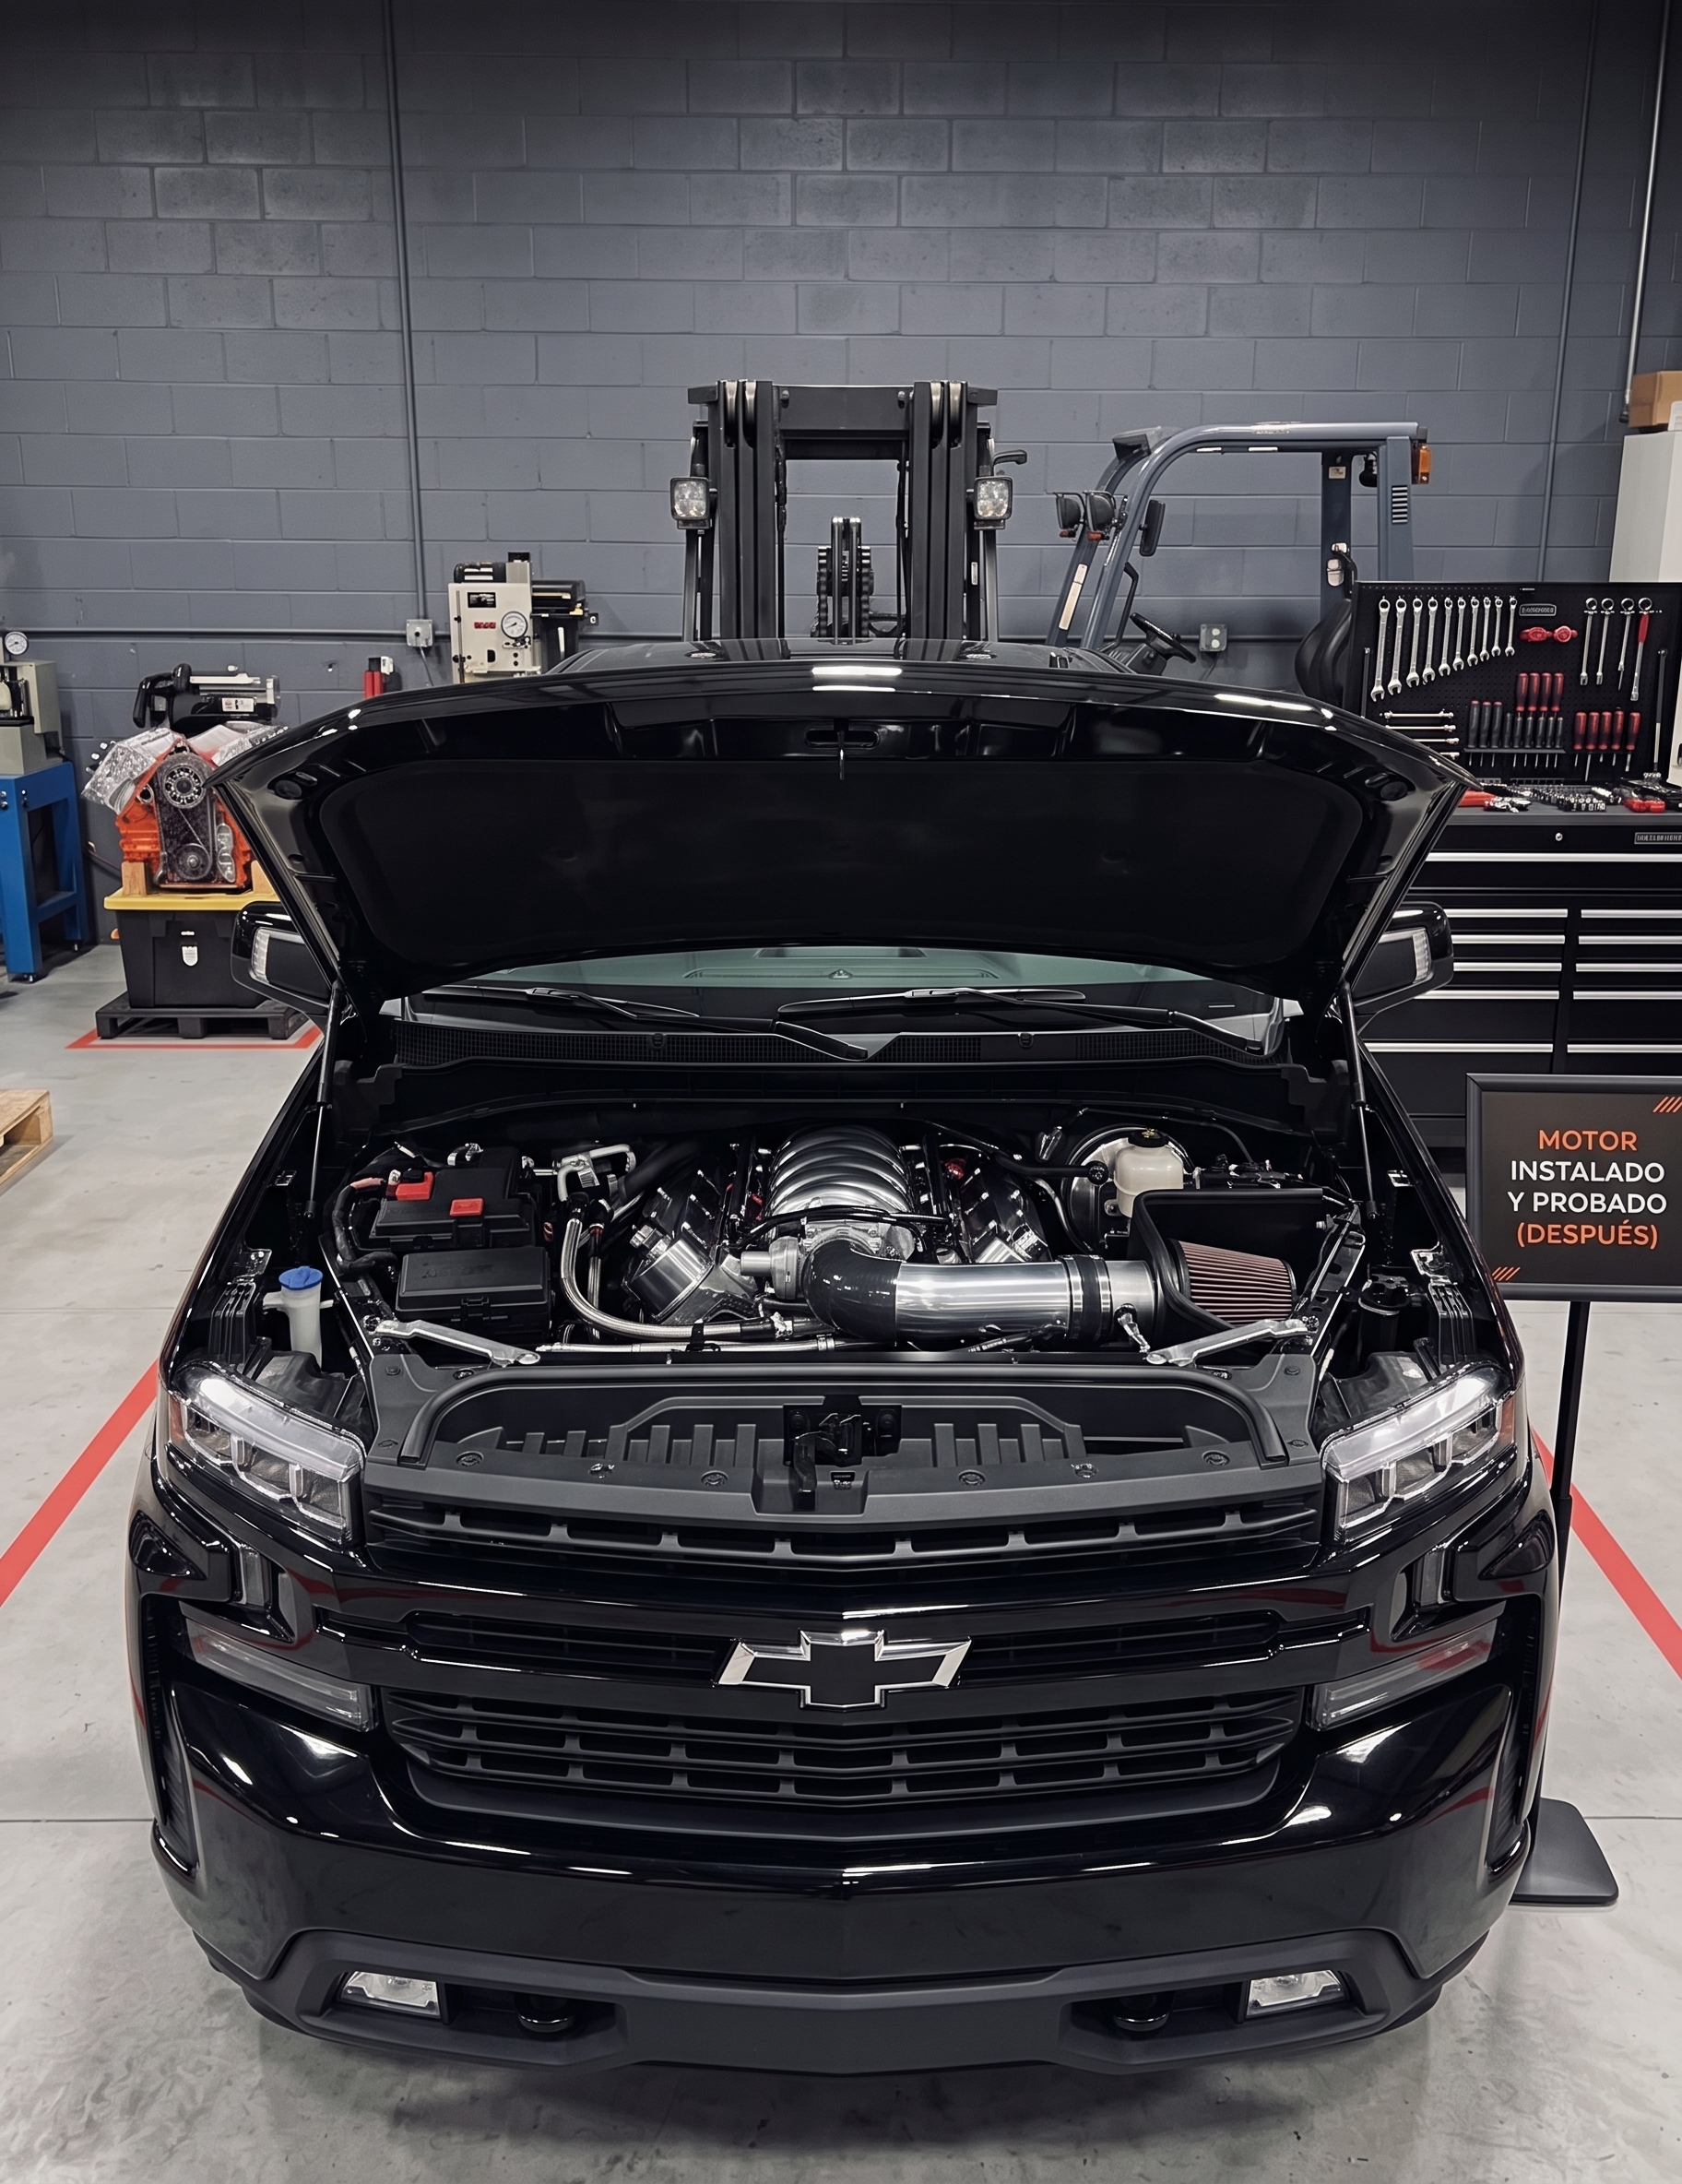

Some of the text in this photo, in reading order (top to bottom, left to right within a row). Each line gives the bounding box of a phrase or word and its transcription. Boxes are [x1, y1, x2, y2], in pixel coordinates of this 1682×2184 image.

[1539, 1130, 1638, 1151] MOTOR
[1510, 1160, 1665, 1183] INSTALADO
[1507, 1192, 1667, 1215] Y PROBADO
[1517, 1219, 1658, 1250] (DESPUÉS)
